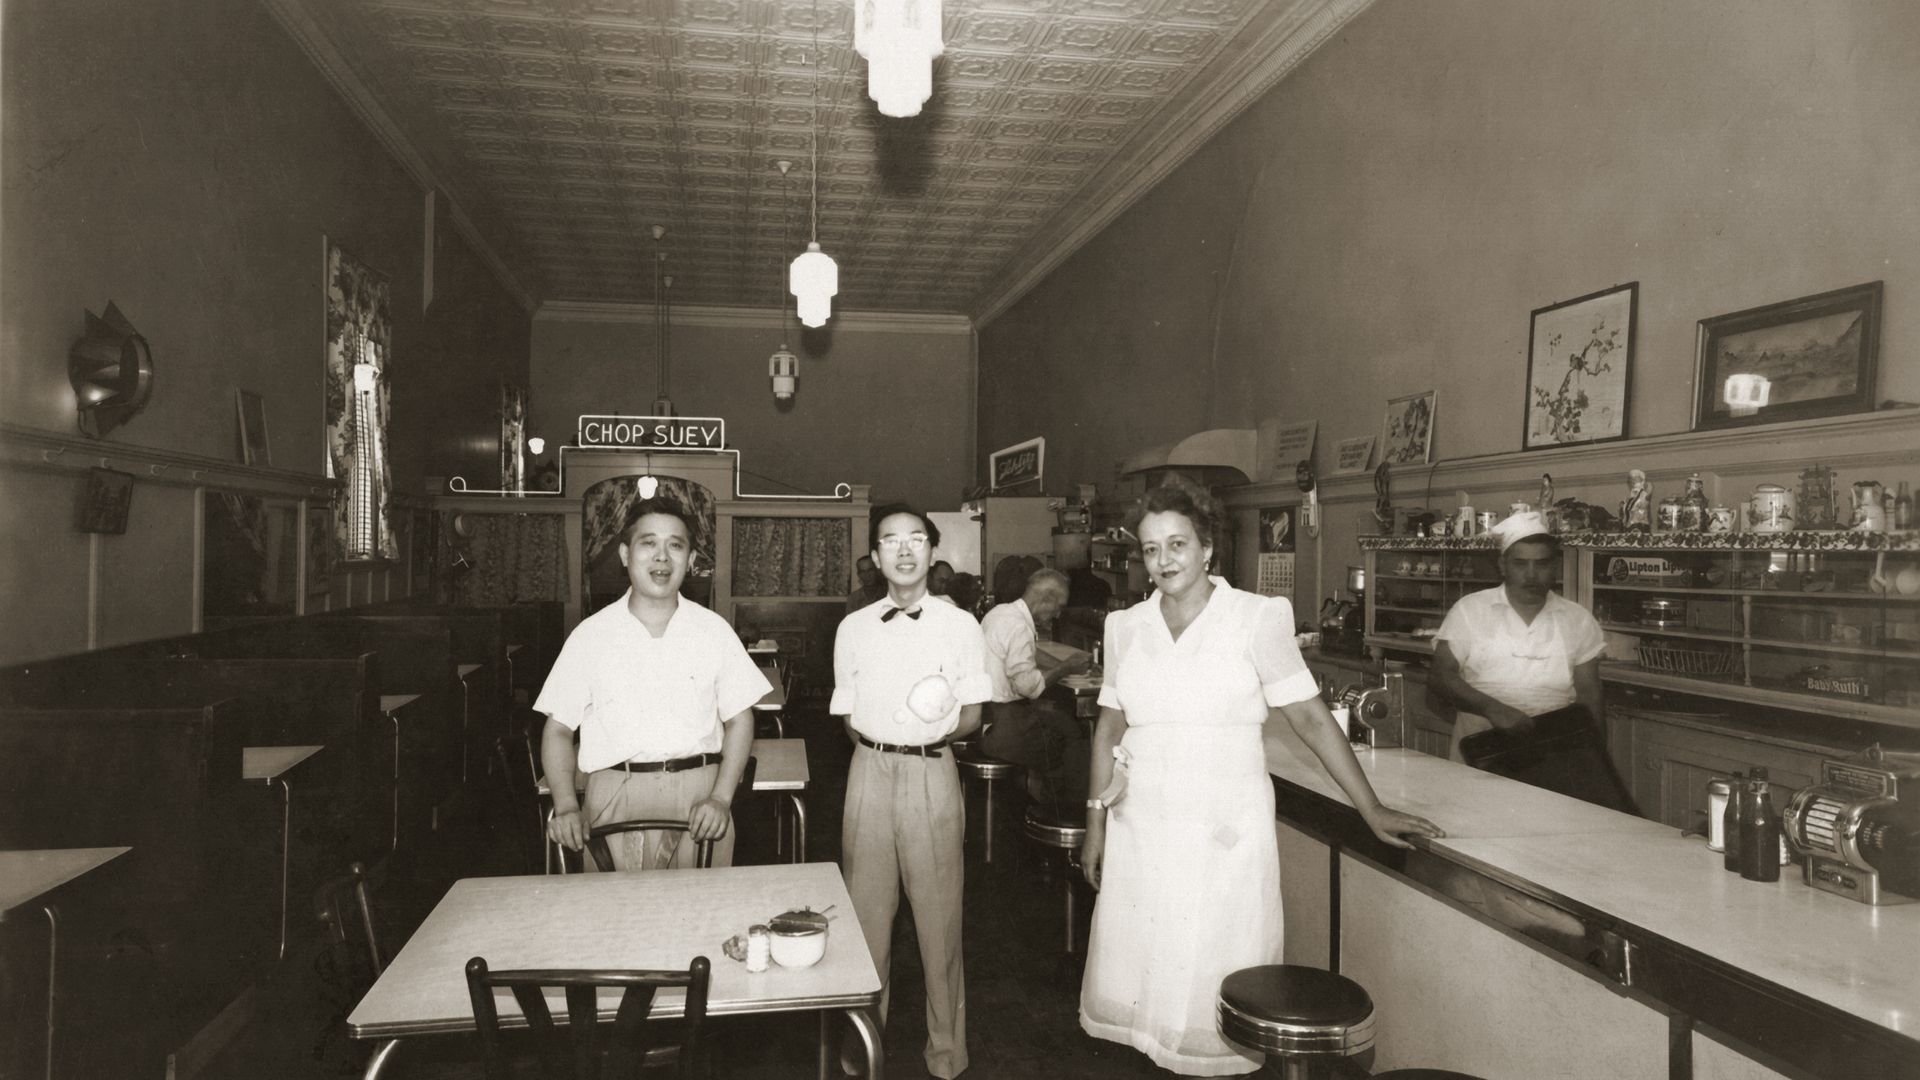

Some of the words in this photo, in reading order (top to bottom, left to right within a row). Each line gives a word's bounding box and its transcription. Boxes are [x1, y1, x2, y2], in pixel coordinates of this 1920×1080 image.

[585, 422, 645, 444] CHOP
[653, 425, 718, 446] SUEY
[1629, 561, 1660, 575] Lipton
[1807, 677, 1831, 692] Baby
[1832, 680, 1860, 695] Ruth
